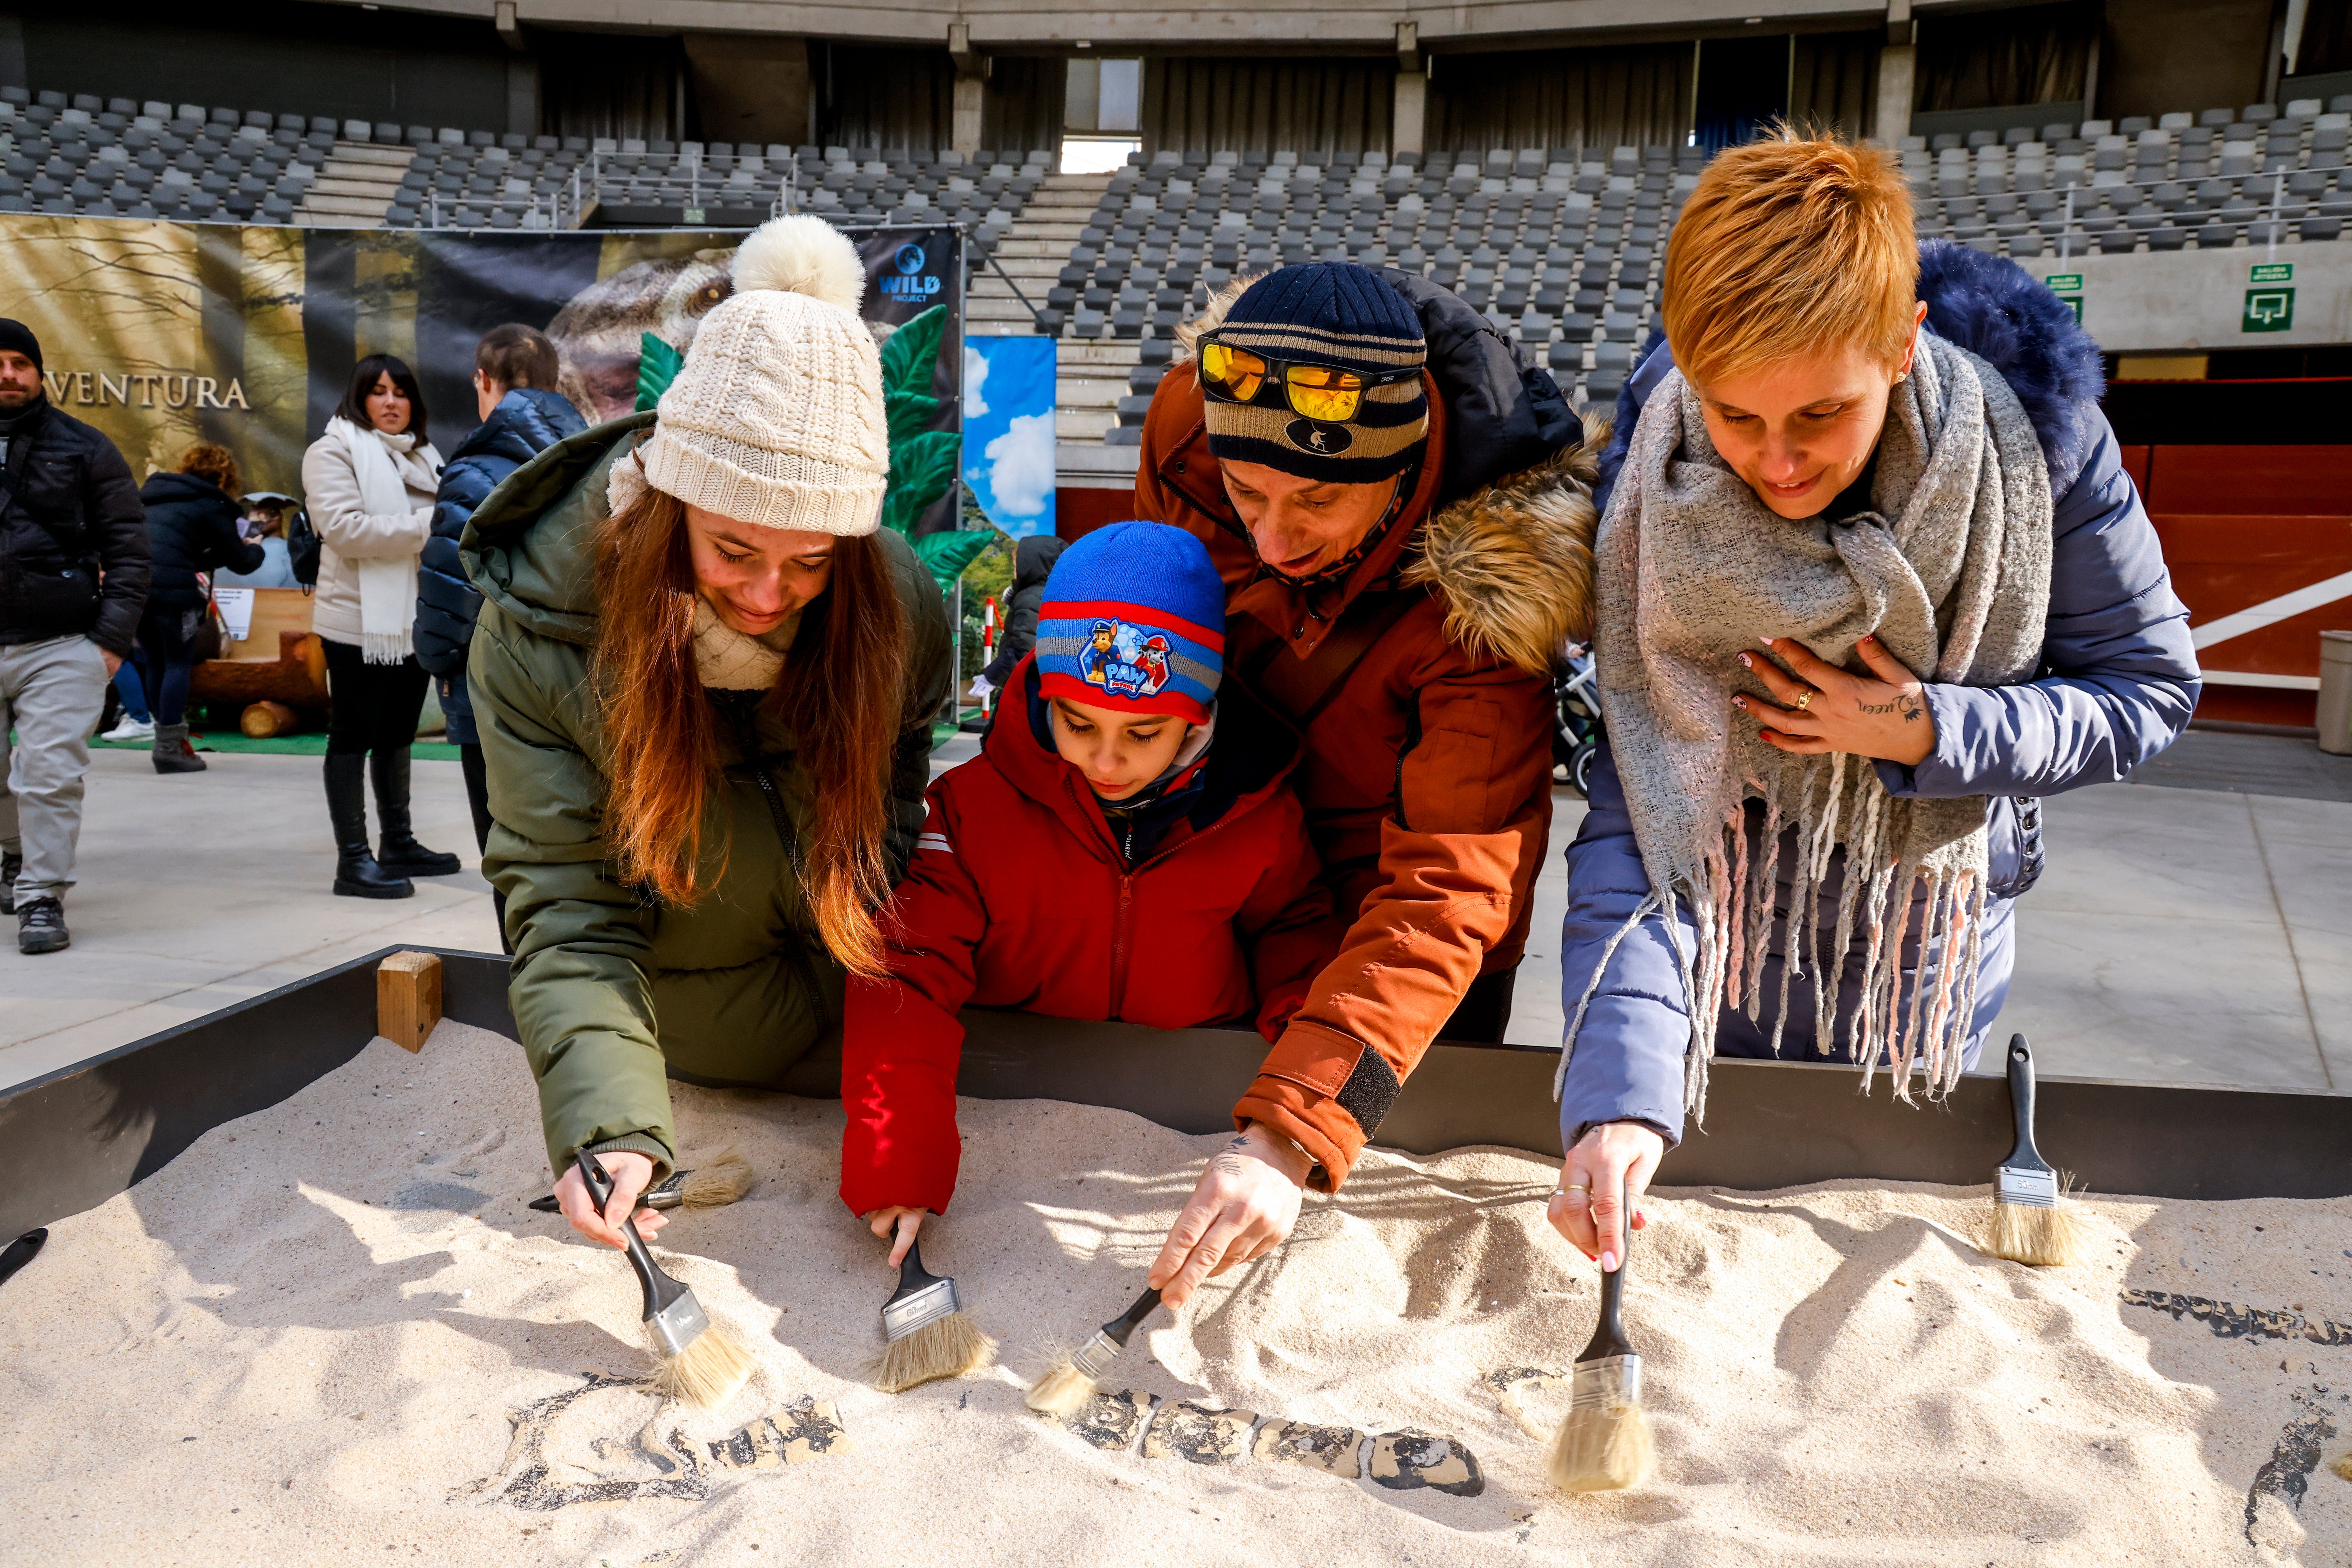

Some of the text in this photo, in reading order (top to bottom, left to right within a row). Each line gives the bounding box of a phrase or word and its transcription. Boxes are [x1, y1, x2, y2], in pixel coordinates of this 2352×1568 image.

[878, 275, 941, 294] WILD
[892, 294, 927, 303] PROJECT
[43, 369, 251, 409] VENTURA
[1105, 664, 1147, 685] PAW
[1112, 682, 1134, 690] PATROL
[1855, 694, 1919, 714] Queen
[2018, 1179, 2039, 1190] 50mm
[907, 1304, 927, 1317] 60mm
